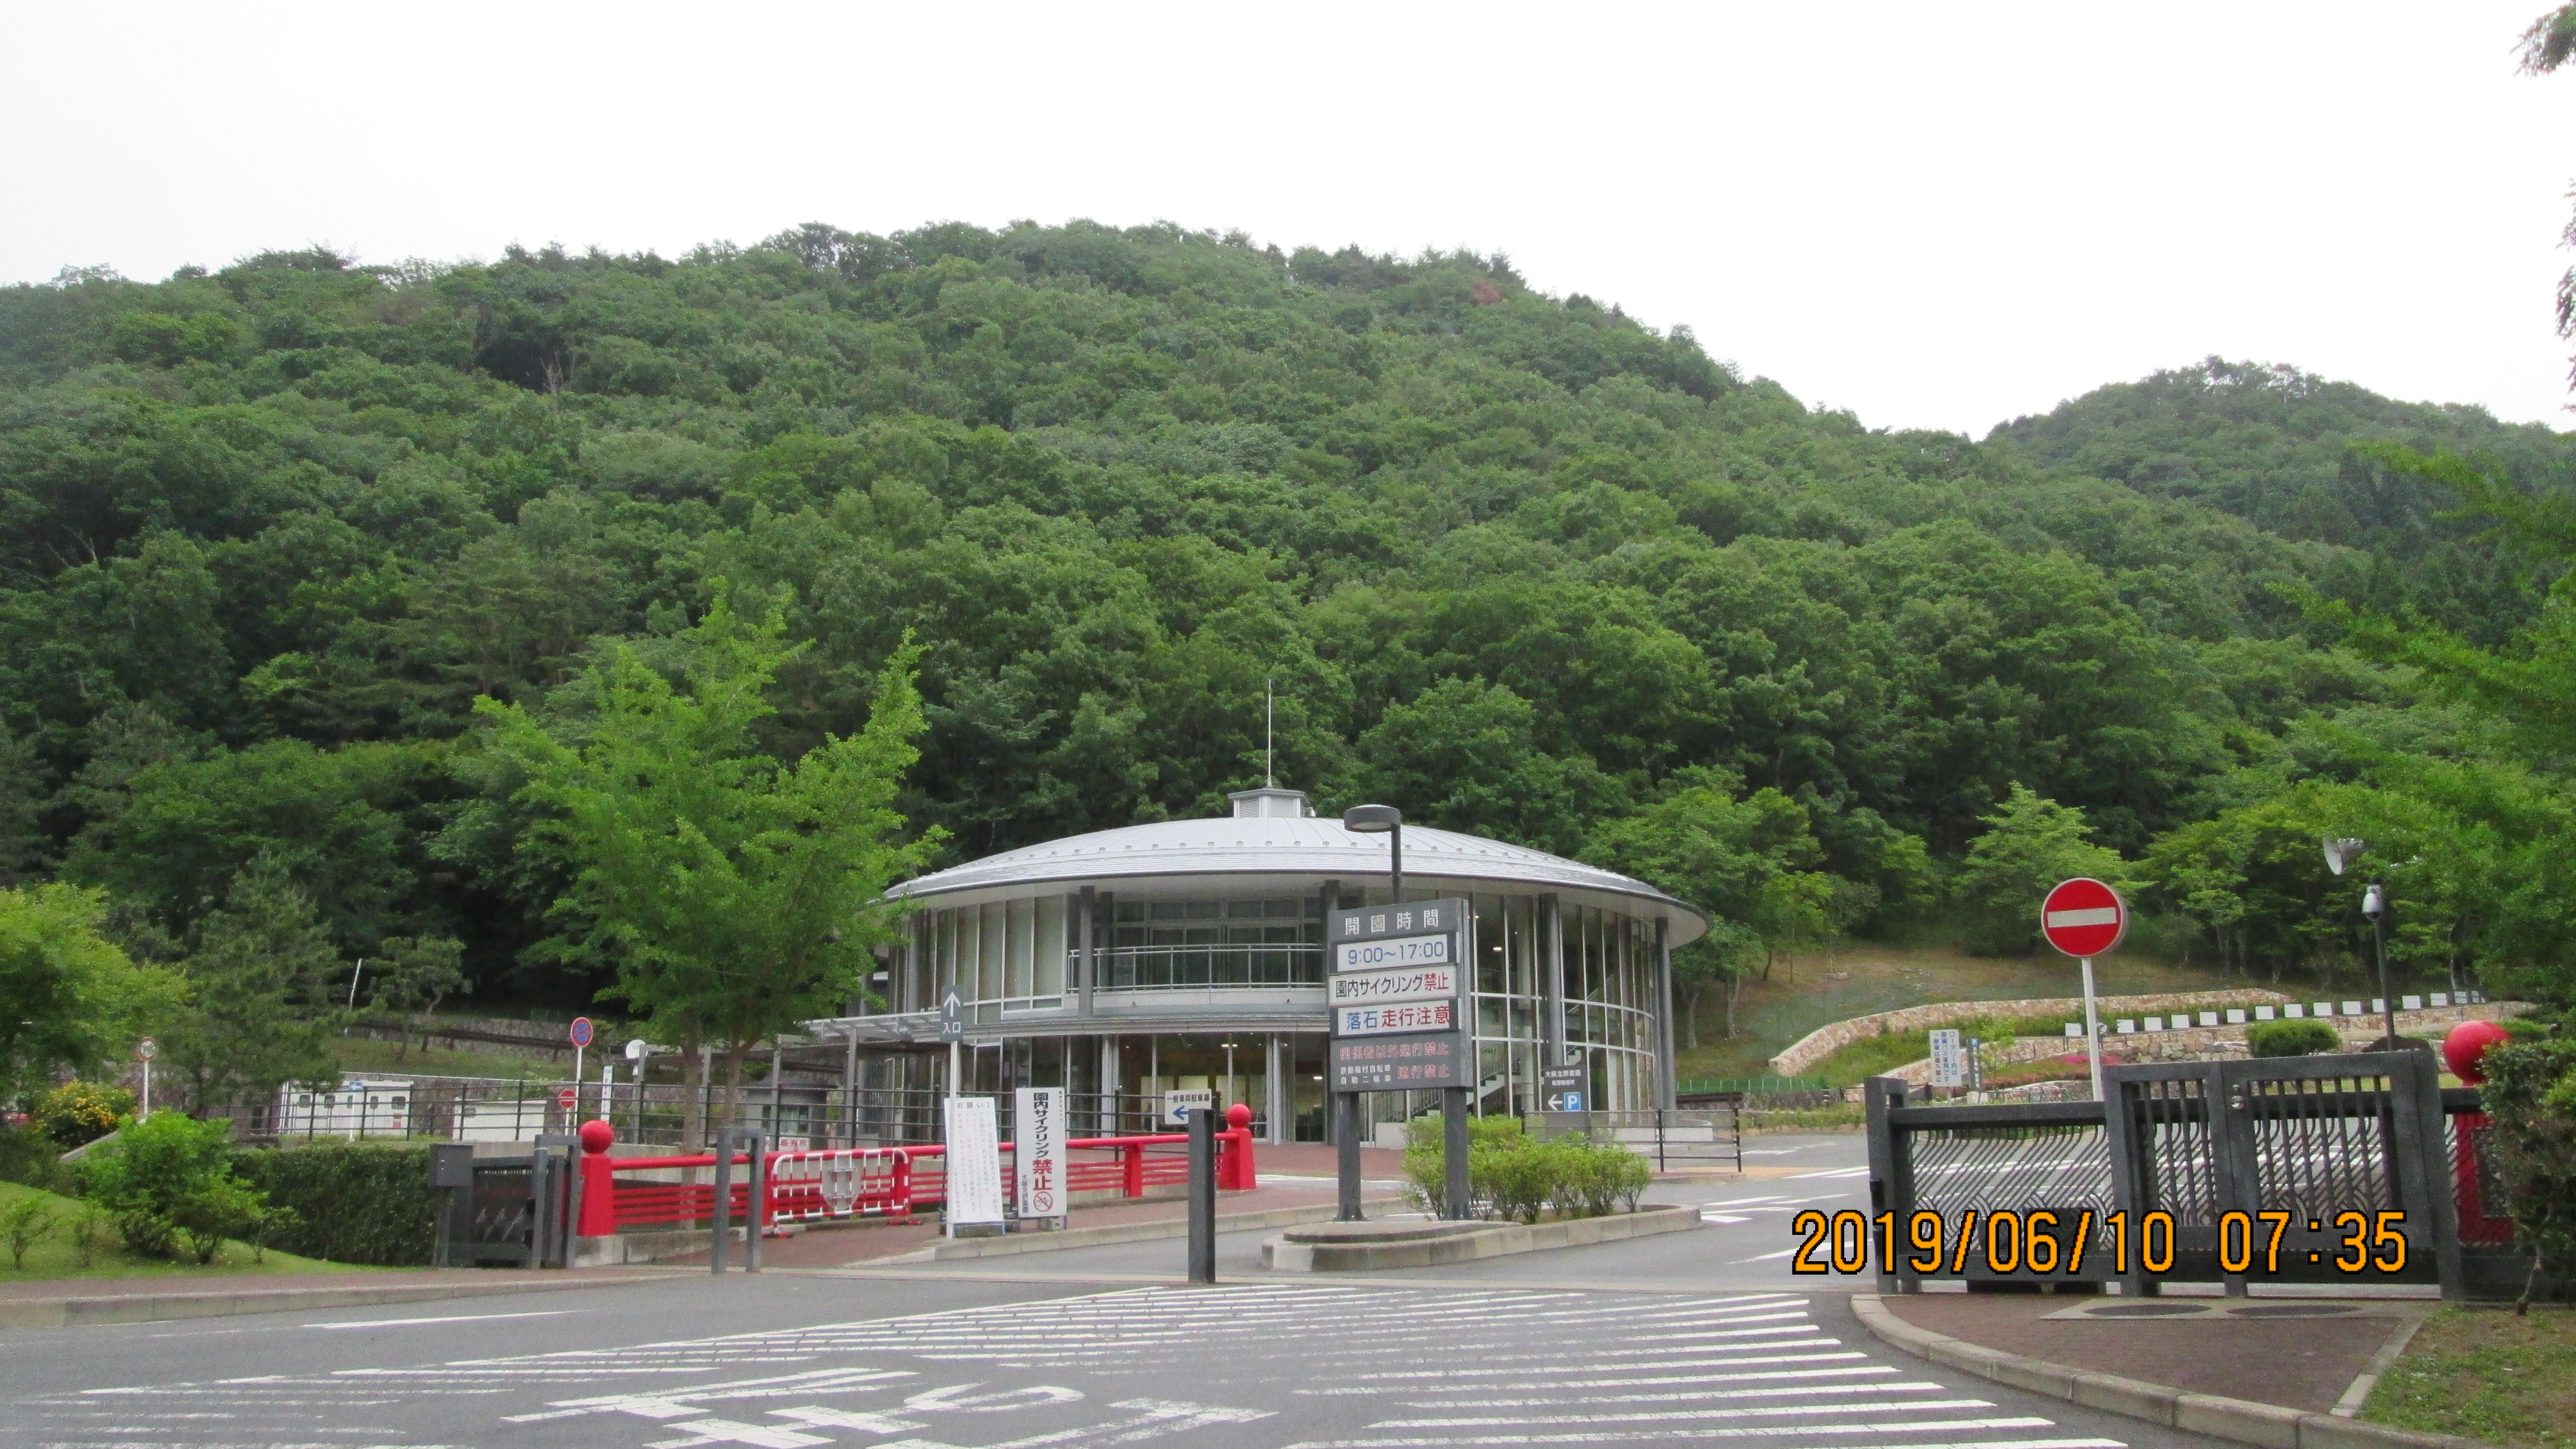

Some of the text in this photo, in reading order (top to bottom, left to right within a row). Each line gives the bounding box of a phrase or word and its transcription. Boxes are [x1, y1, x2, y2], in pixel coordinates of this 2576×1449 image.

[1344, 908, 1439, 935] 開園時間
[1336, 972, 1449, 998] 園内サイクリング禁止
[942, 1022, 960, 1034] 入口
[1568, 1095, 1578, 1109] P
[1033, 1092, 1052, 1191] 園内サイクリング禁止
